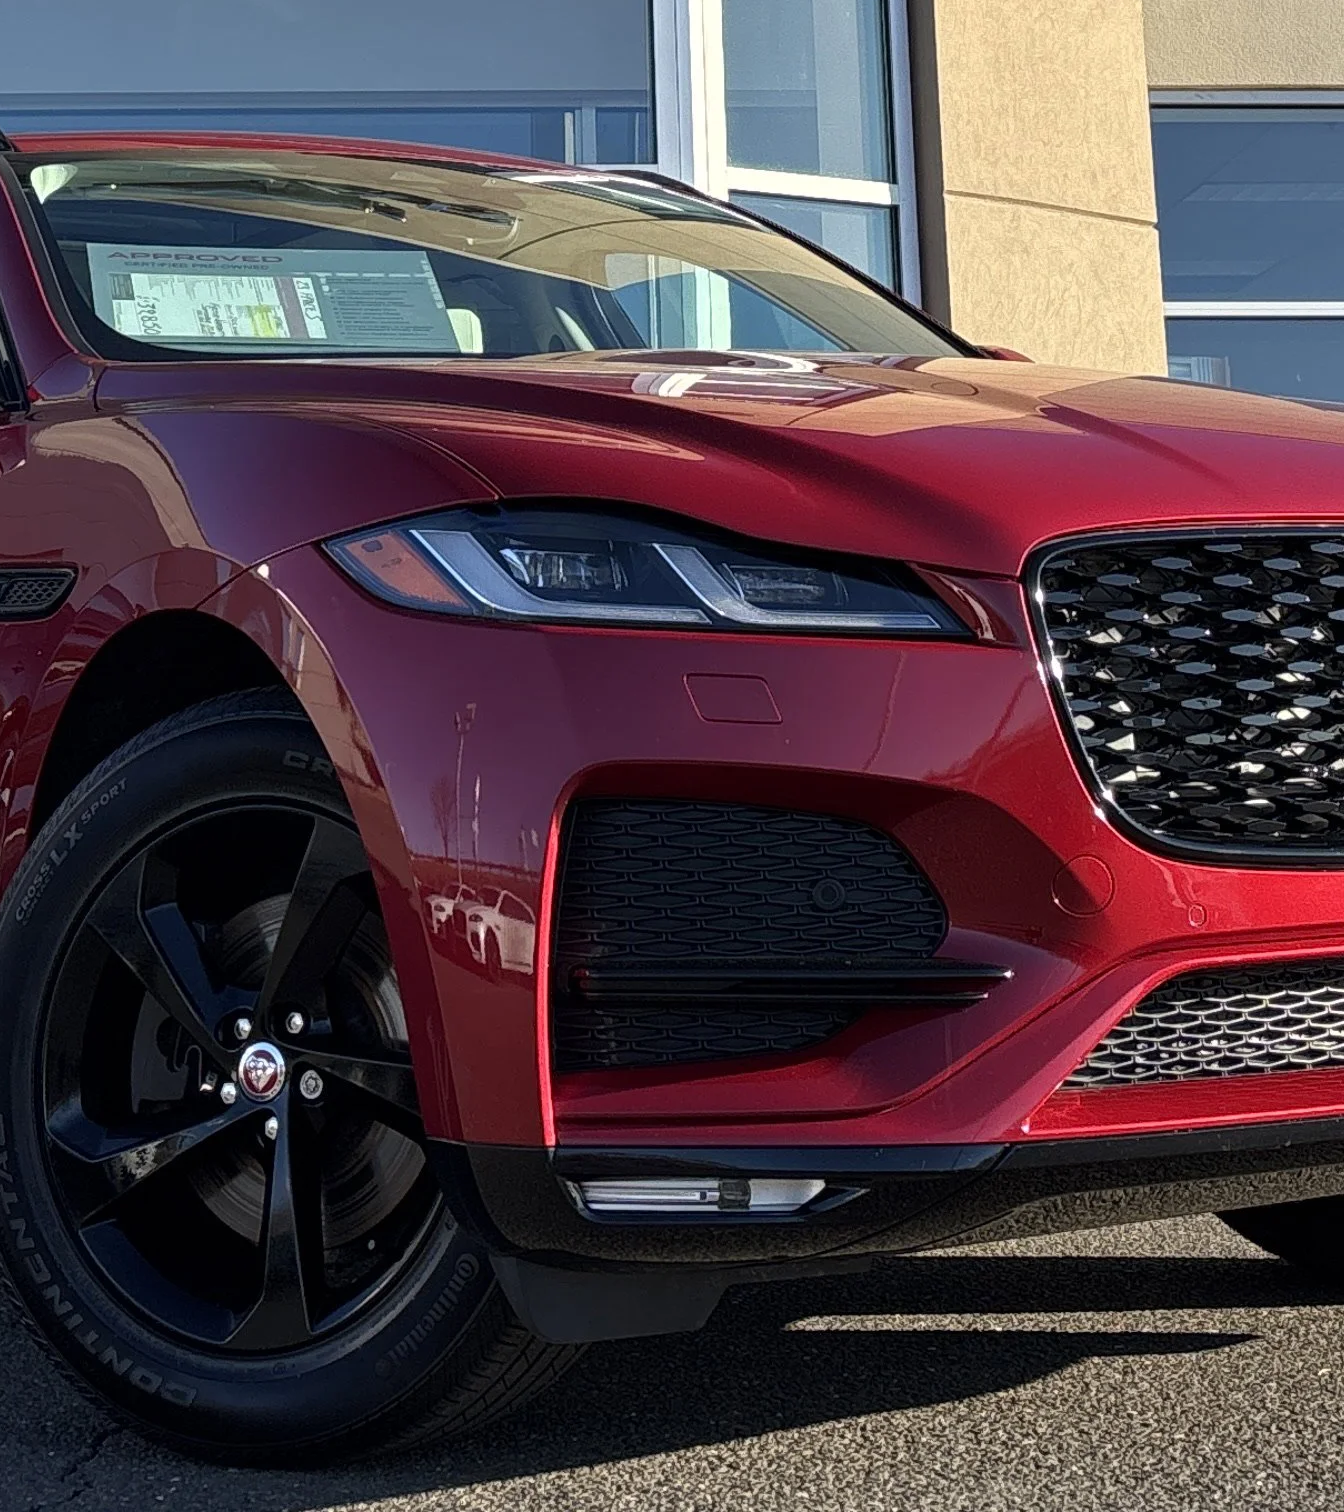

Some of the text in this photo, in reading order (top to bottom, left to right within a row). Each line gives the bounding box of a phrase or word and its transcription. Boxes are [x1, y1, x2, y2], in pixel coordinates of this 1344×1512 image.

[108, 251, 282, 263] APPROVED
[124, 261, 269, 271] CERTIFIED PRE-OWNED
[80, 777, 128, 825] SPORT
